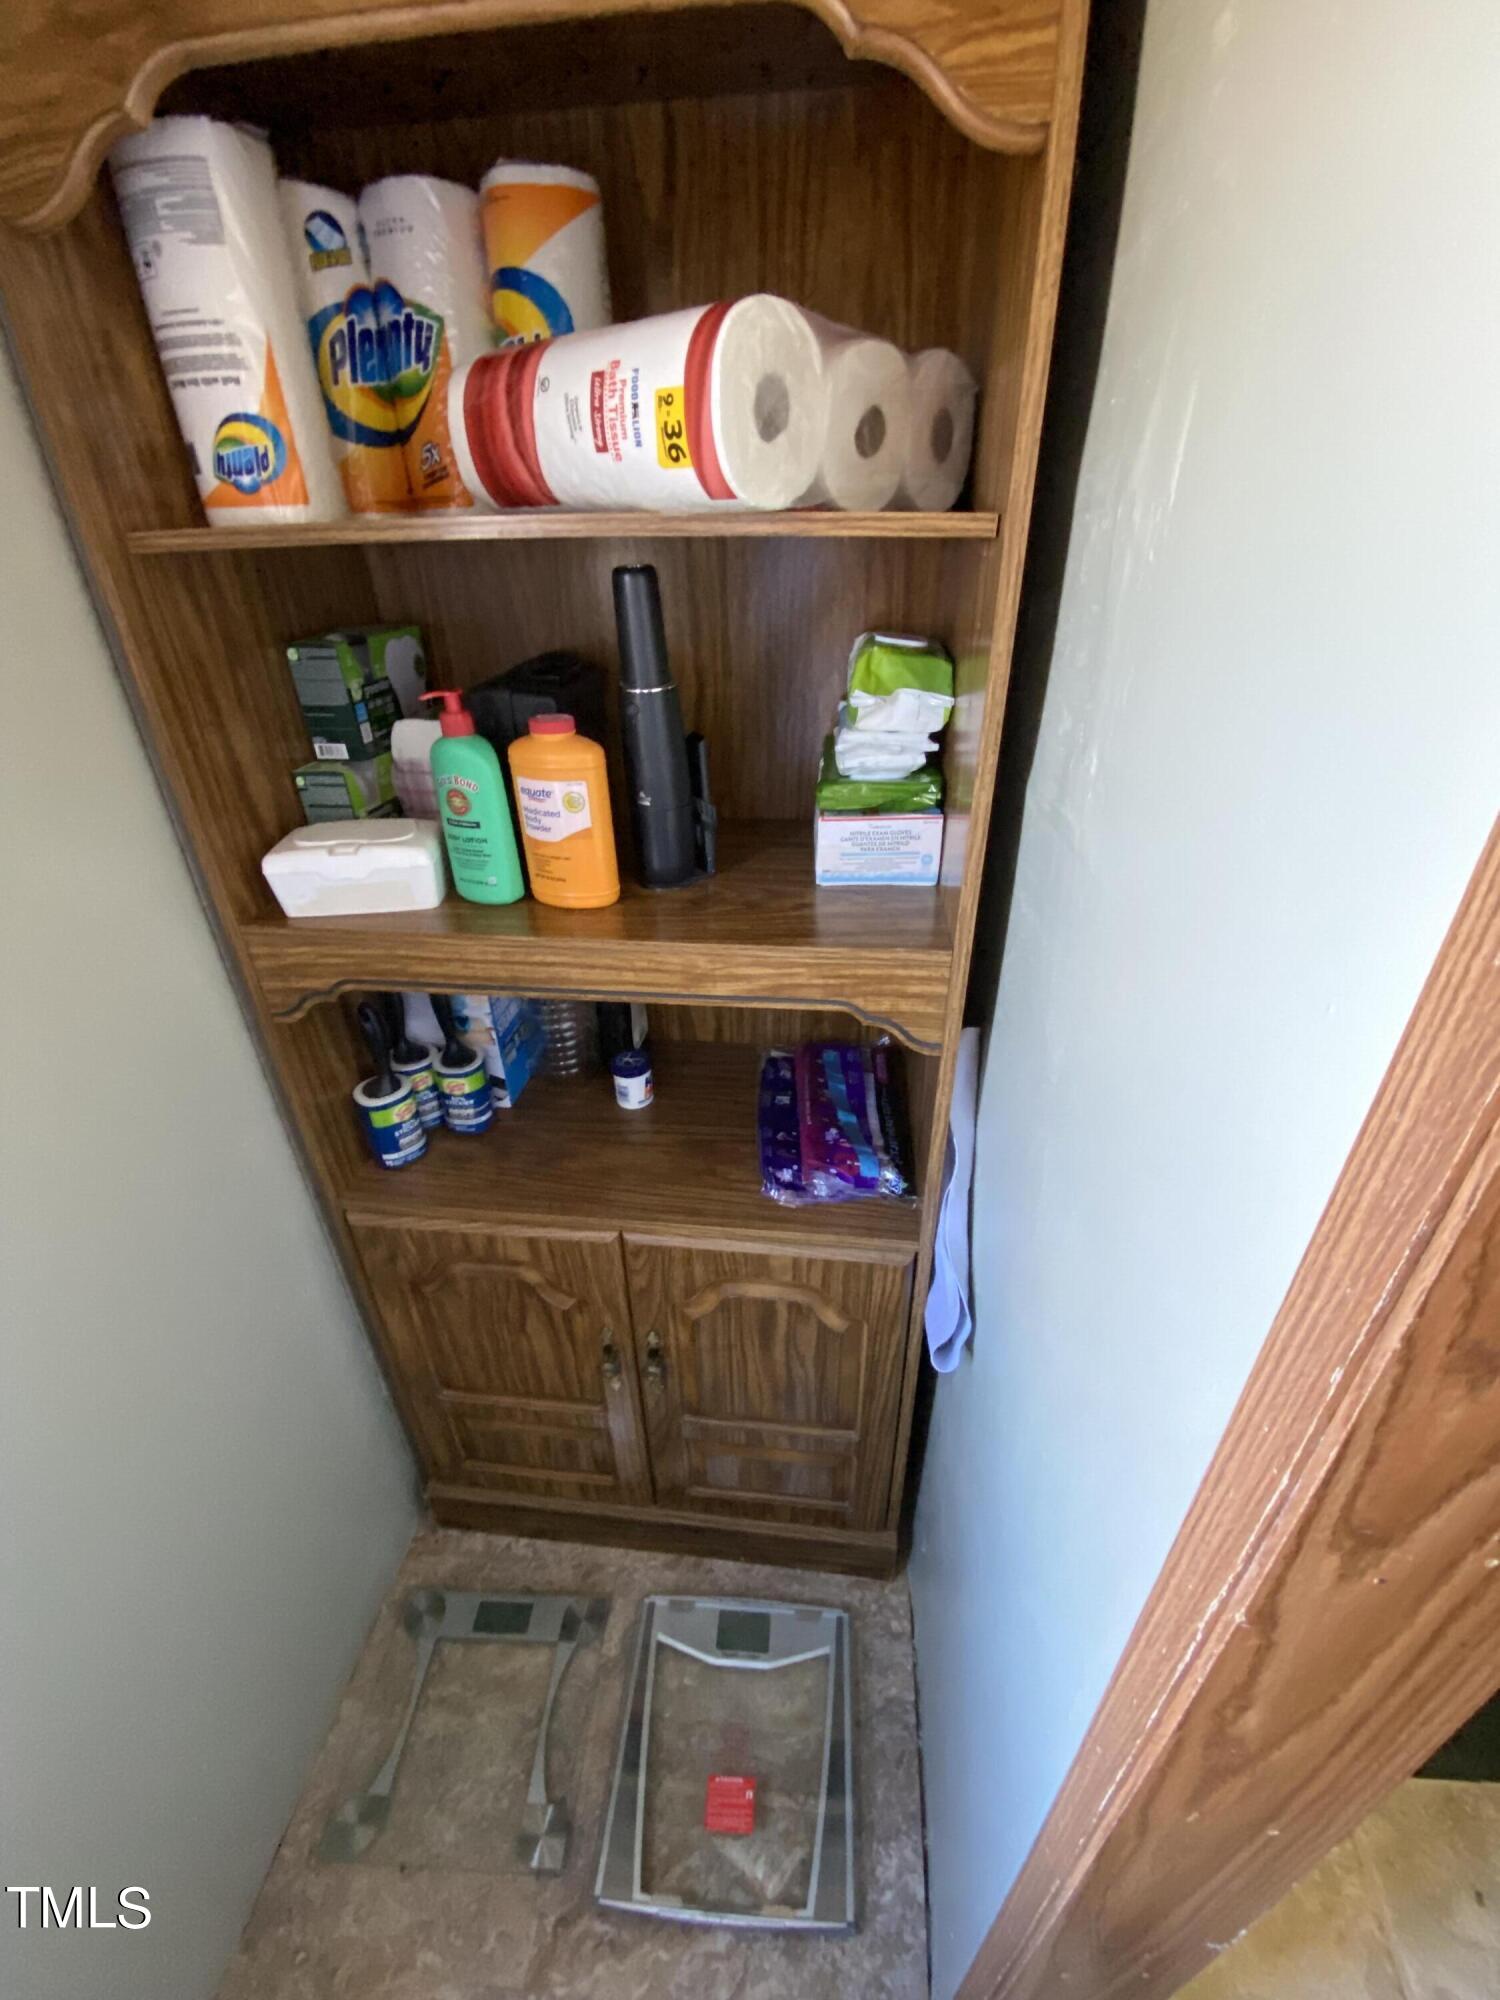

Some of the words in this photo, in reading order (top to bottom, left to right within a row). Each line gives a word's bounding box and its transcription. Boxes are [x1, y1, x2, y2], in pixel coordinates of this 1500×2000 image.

[608, 360, 621, 399] Bath
[631, 368, 640, 400] FOOD
[618, 379, 628, 440] Premium
[608, 403, 623, 462] Tissue
[632, 420, 642, 448] LION
